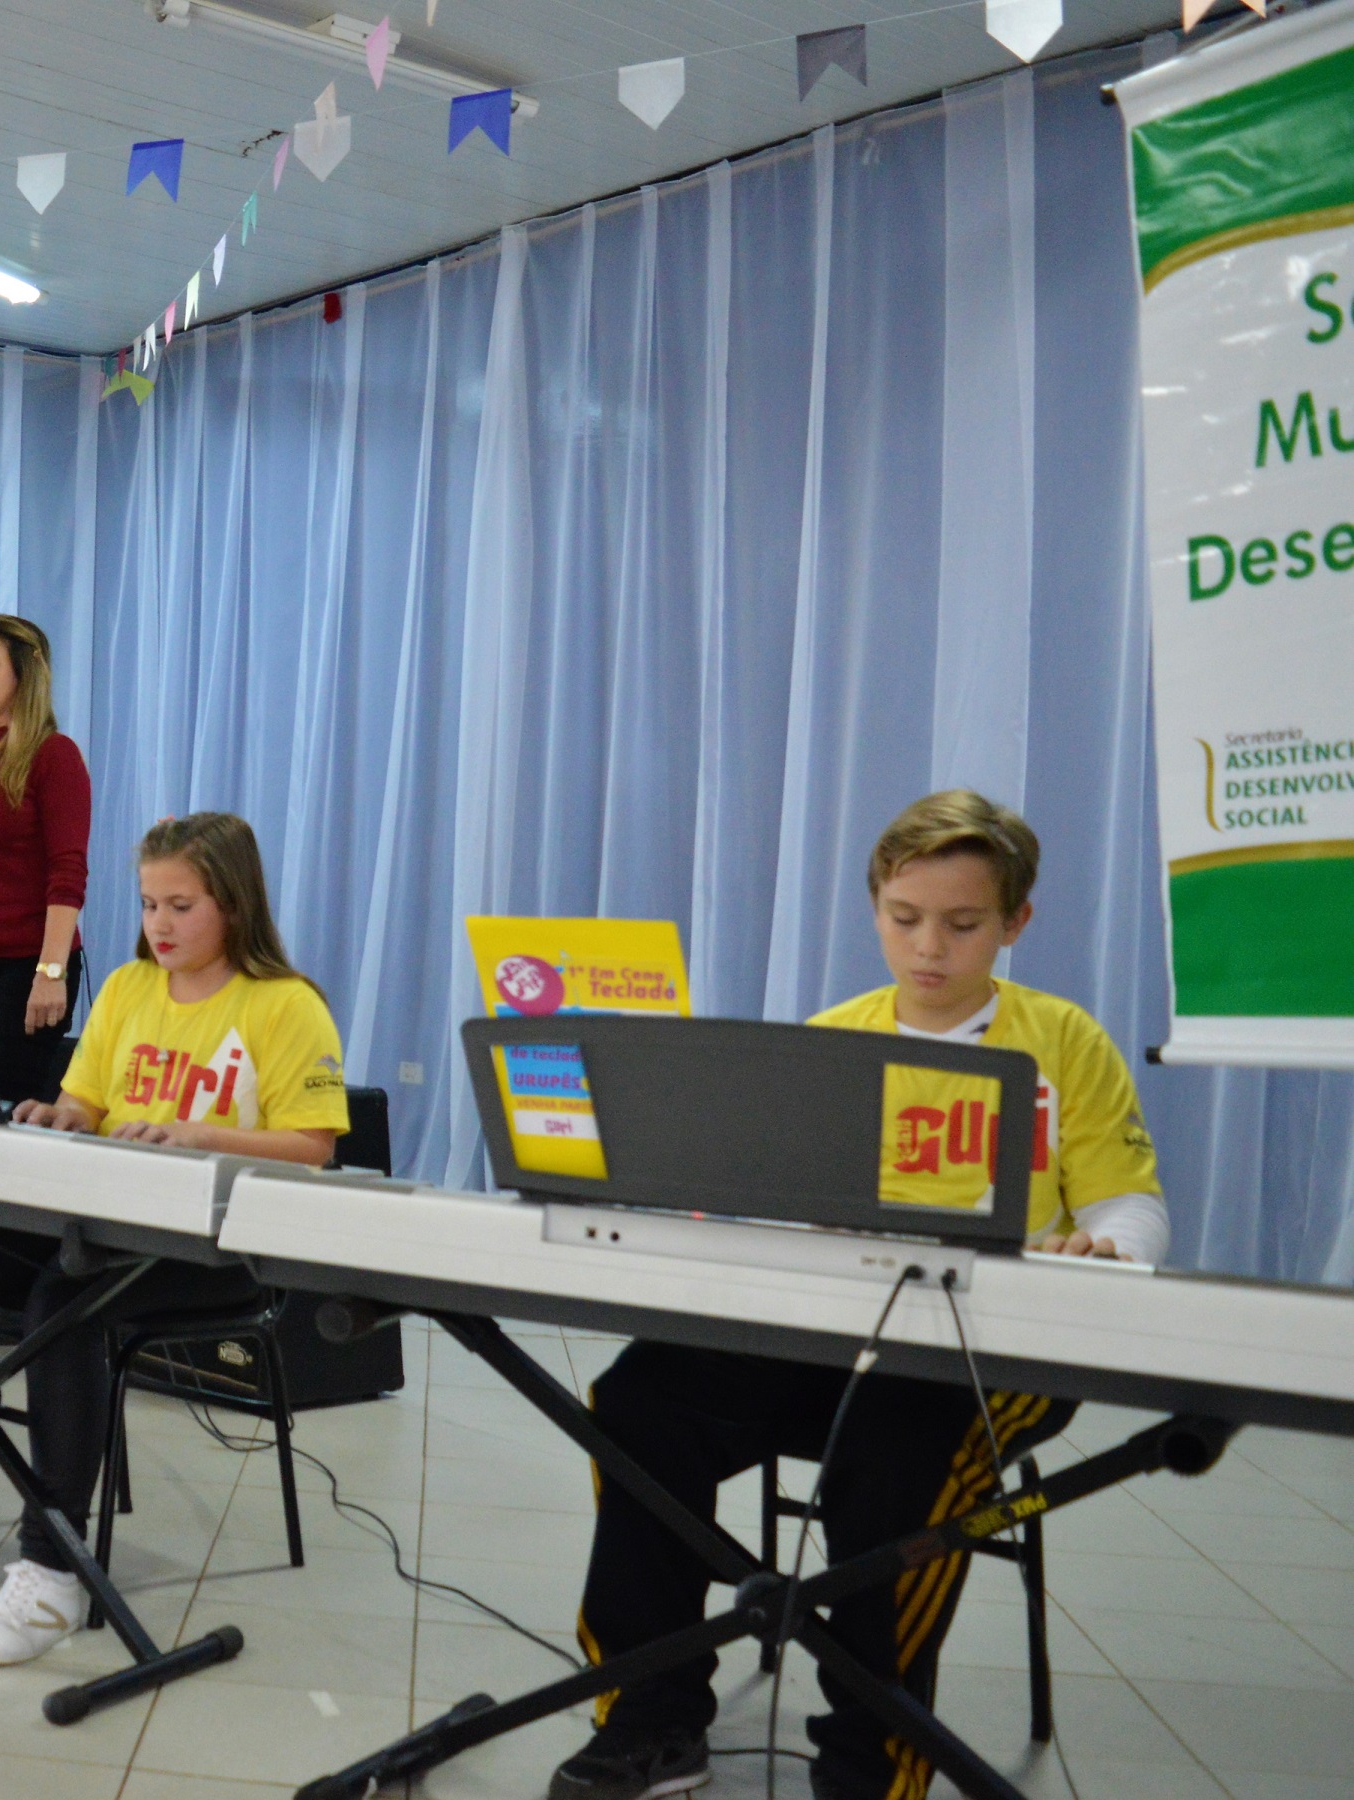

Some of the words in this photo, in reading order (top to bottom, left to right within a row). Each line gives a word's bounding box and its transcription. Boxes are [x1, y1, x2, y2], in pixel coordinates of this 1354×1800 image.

[1304, 271, 1354, 345] S
[1188, 522, 1354, 602] Dese
[1225, 728, 1304, 748] Secretaria
[1225, 805, 1308, 829] SOCIAL
[622, 968, 664, 982] Cena
[590, 981, 675, 1000] Teclado
[124, 1043, 243, 1122] Guri
[513, 1071, 582, 1090] URUPÊS
